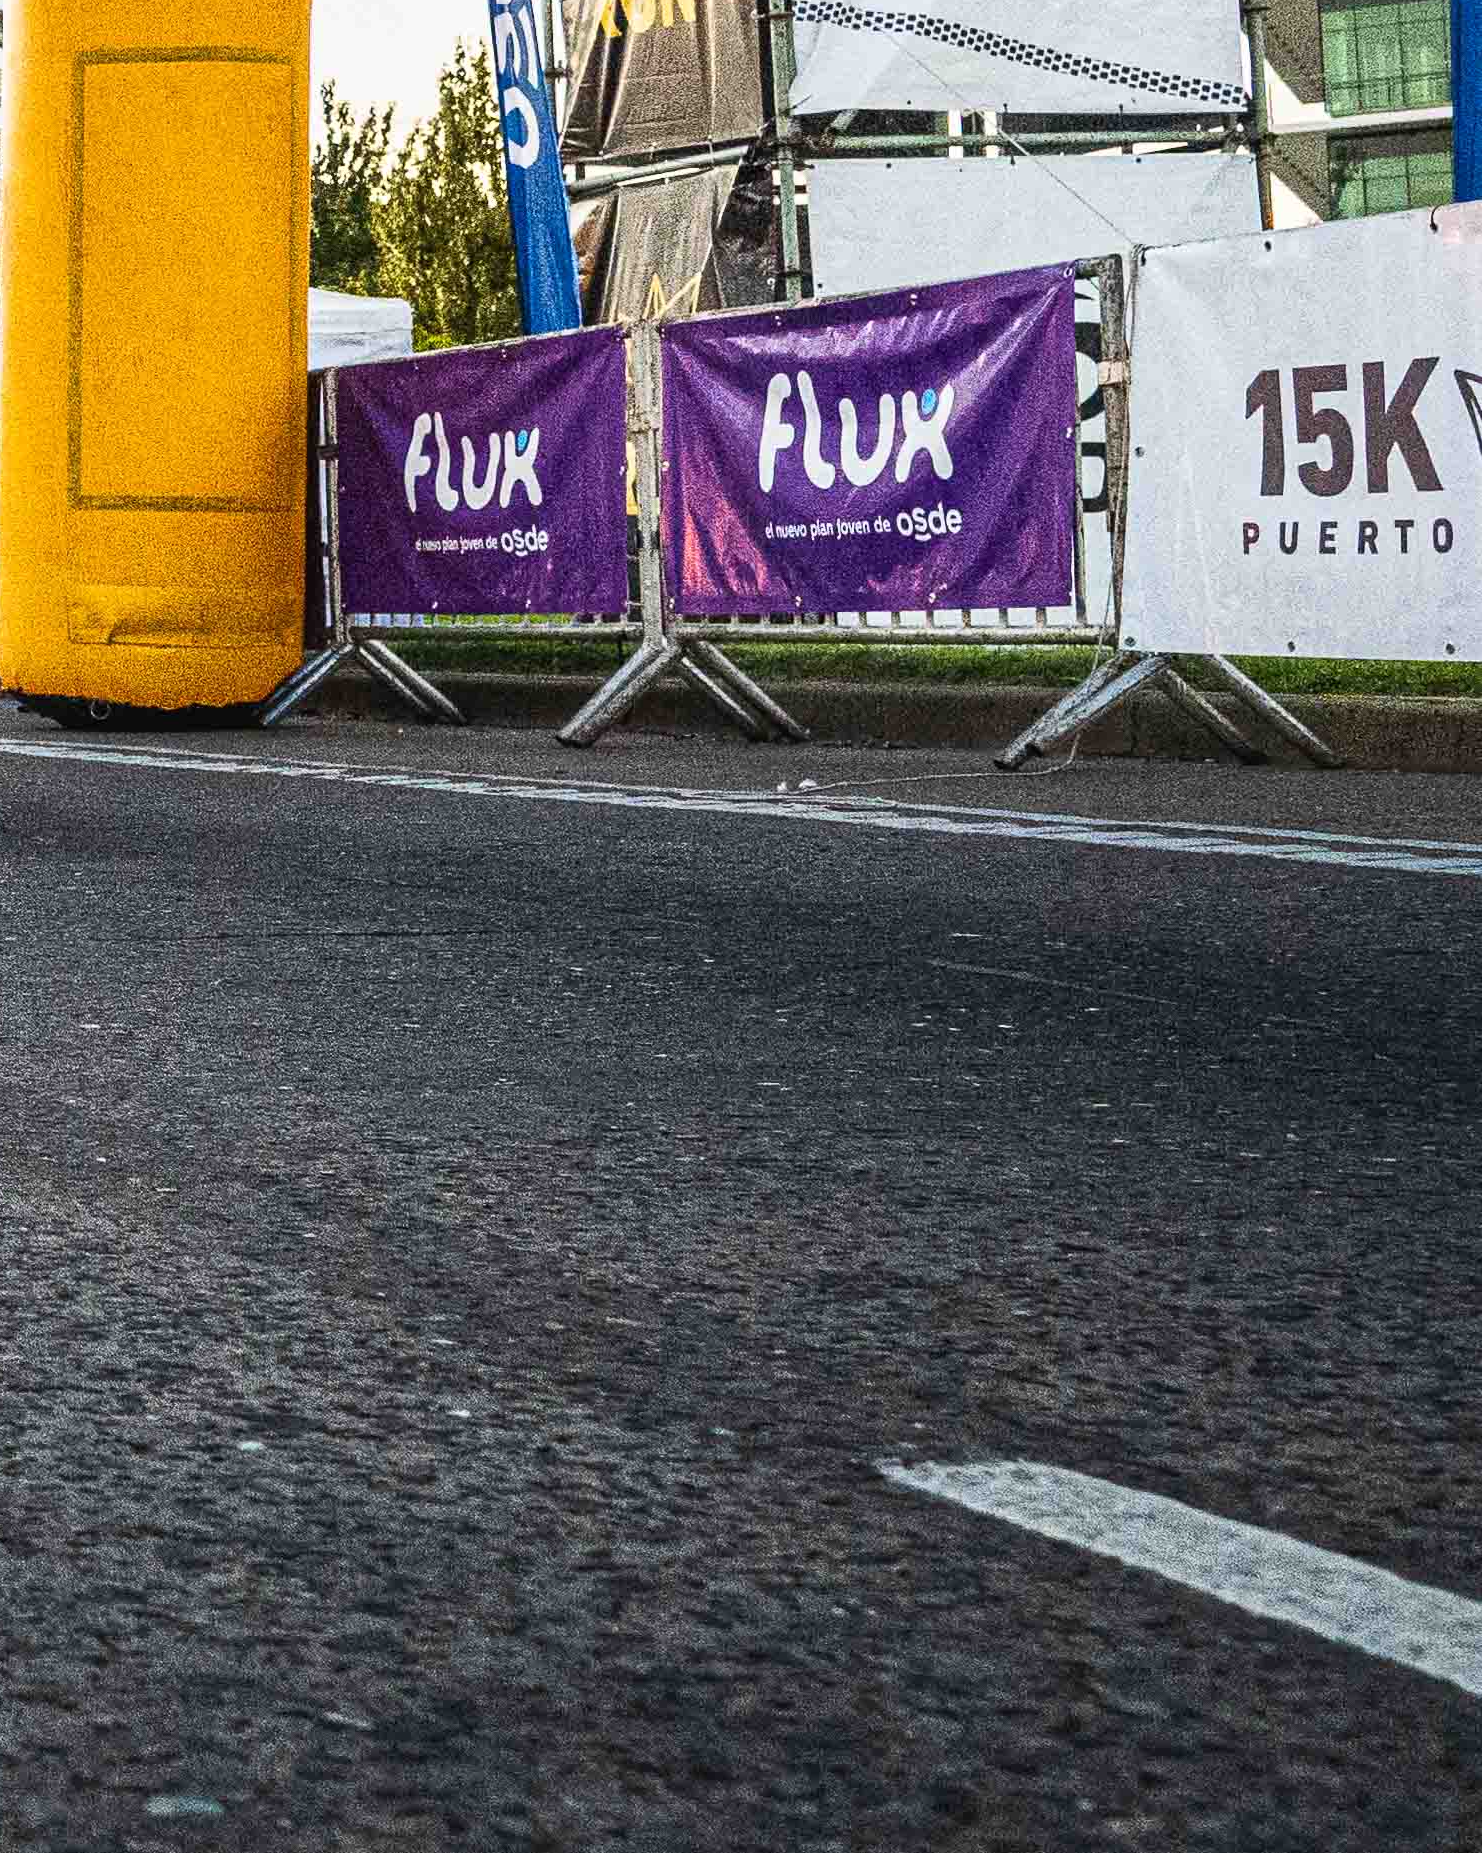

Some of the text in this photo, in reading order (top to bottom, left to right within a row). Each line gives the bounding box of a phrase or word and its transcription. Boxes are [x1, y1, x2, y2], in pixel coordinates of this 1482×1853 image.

[1245, 356, 1444, 497] 15K
[486, 535, 498, 549] de
[501, 523, 549, 557] osde
[765, 501, 963, 541] el nuevo plan joven de osde
[1242, 518, 1454, 555] PUERTO
